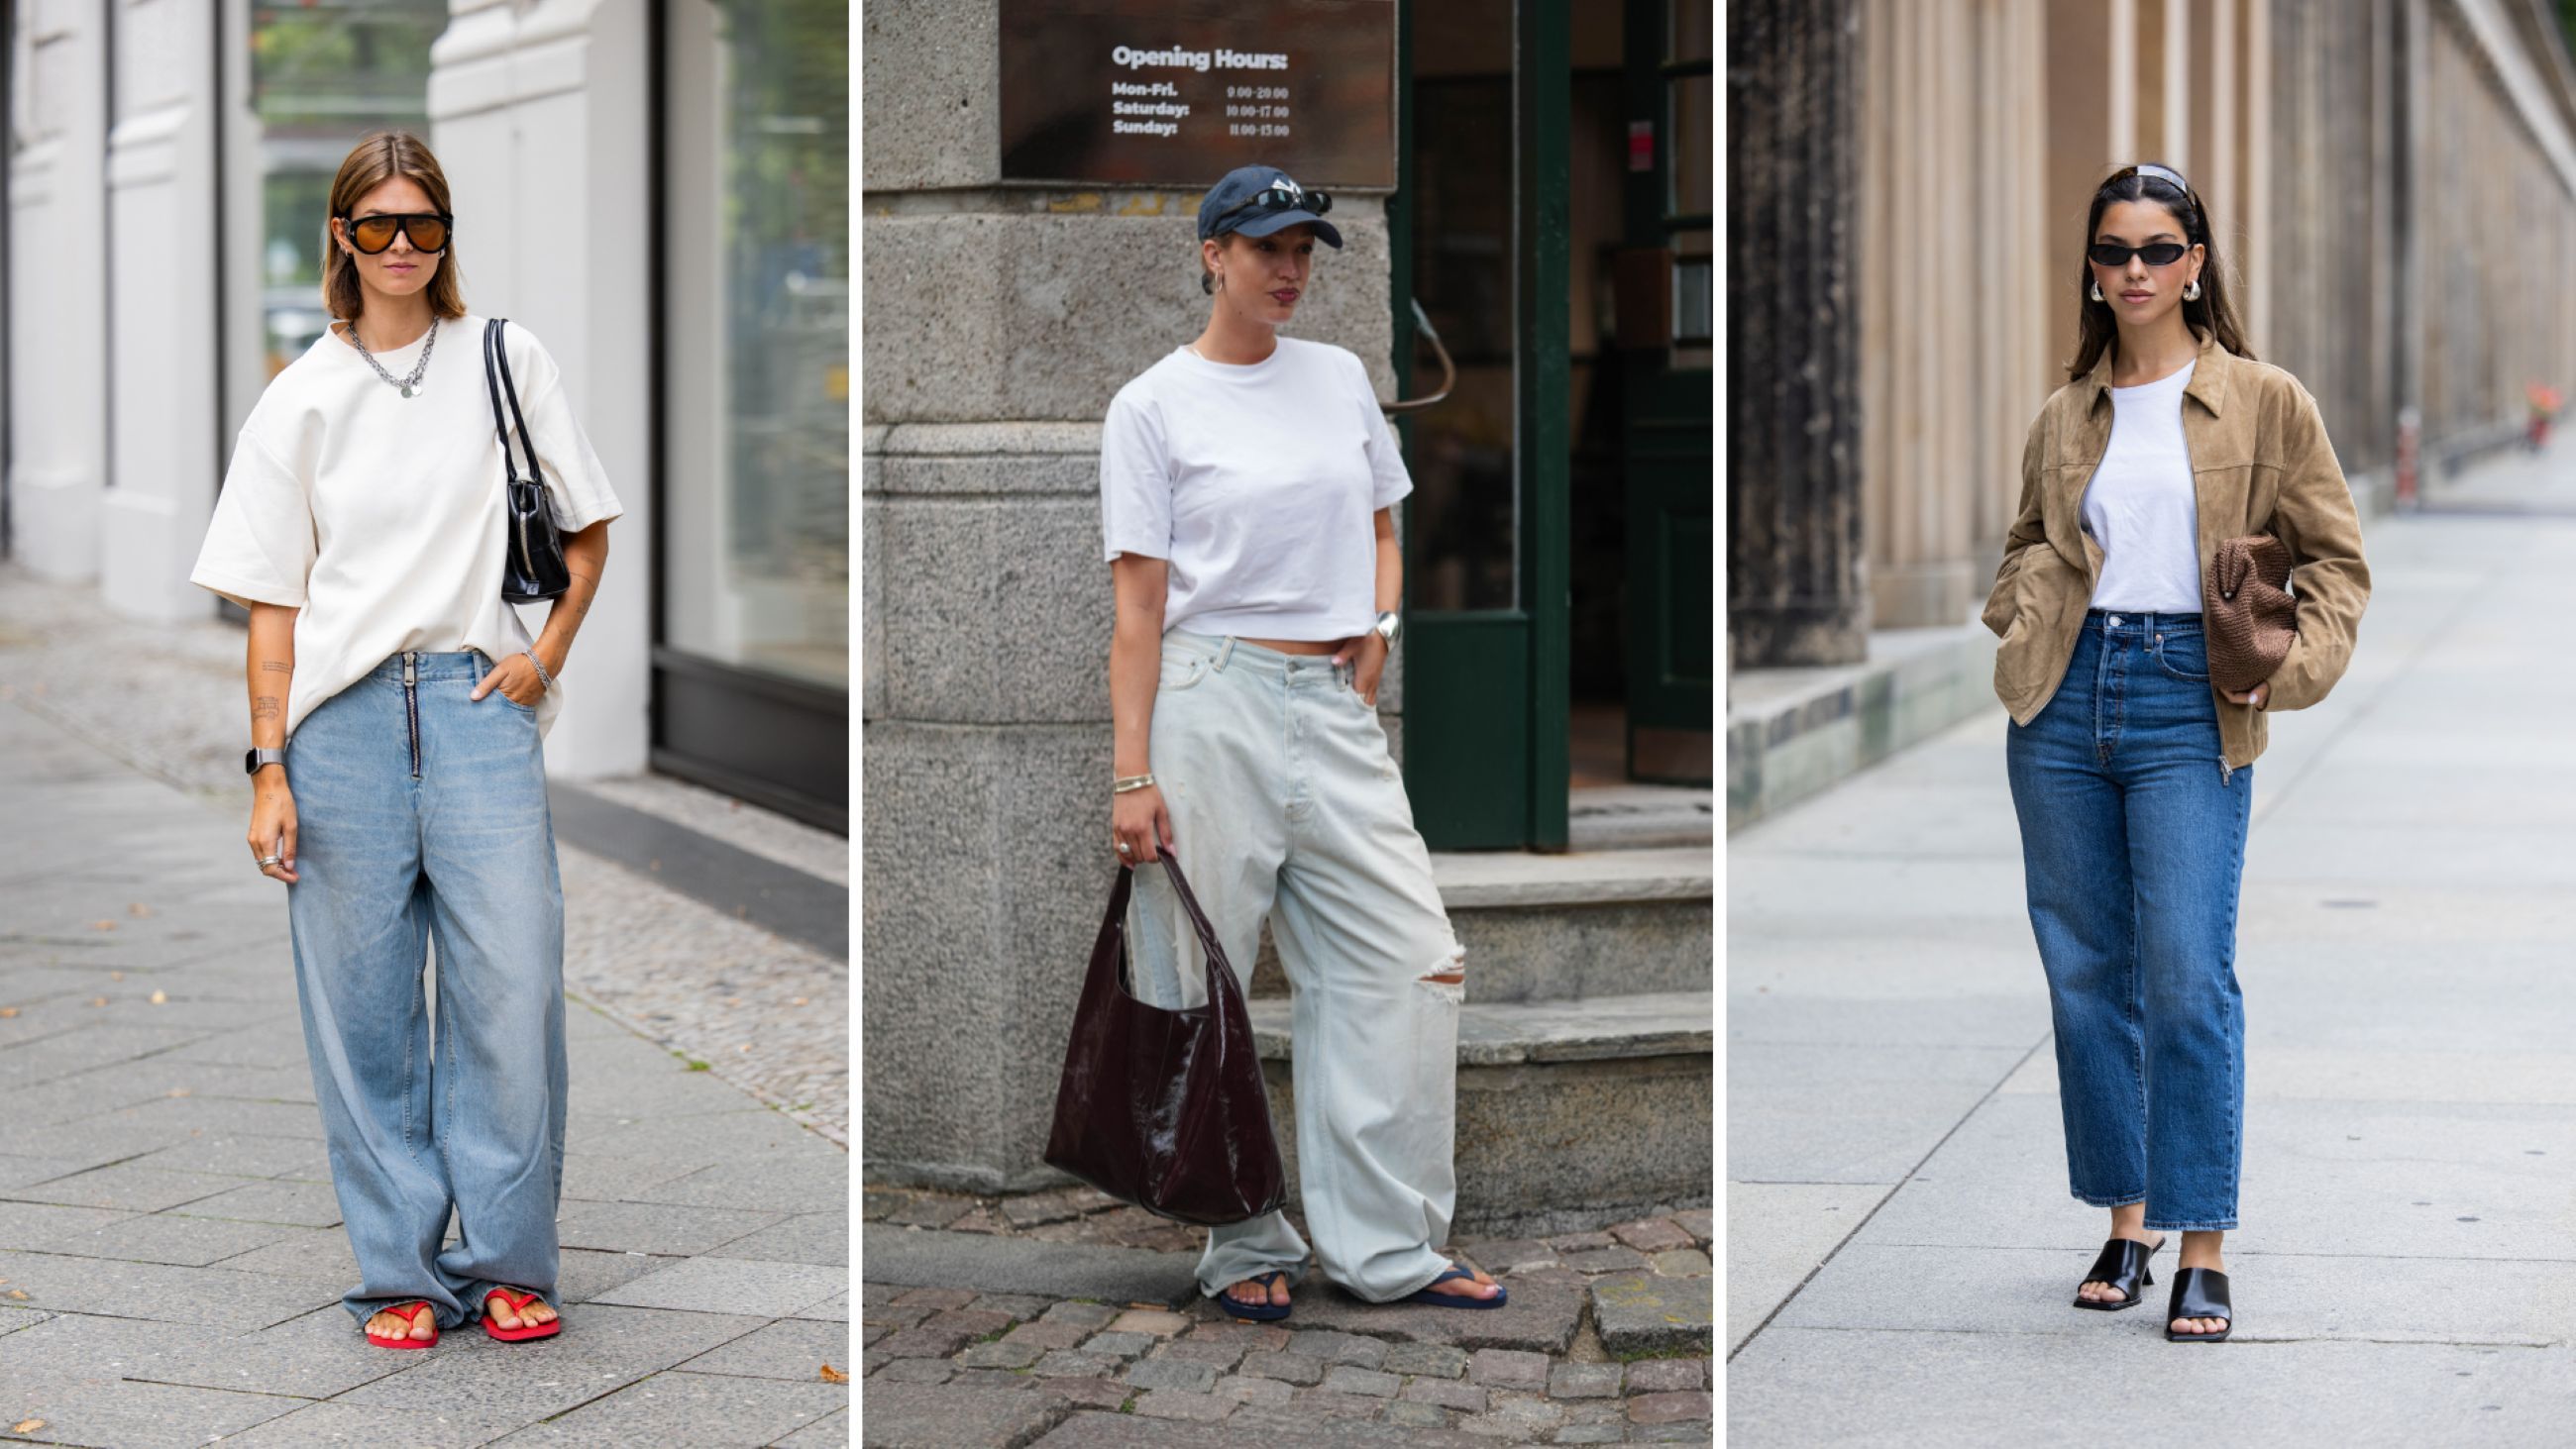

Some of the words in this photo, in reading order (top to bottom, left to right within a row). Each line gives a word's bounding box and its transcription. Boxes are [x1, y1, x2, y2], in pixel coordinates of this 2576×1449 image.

[1112, 46, 1210, 71] Opening
[1215, 50, 1288, 70] Hours:
[1112, 81, 1178, 97] Mon-Fri.
[1113, 101, 1190, 119] Saturday:
[1113, 120, 1178, 137] Sunday:
